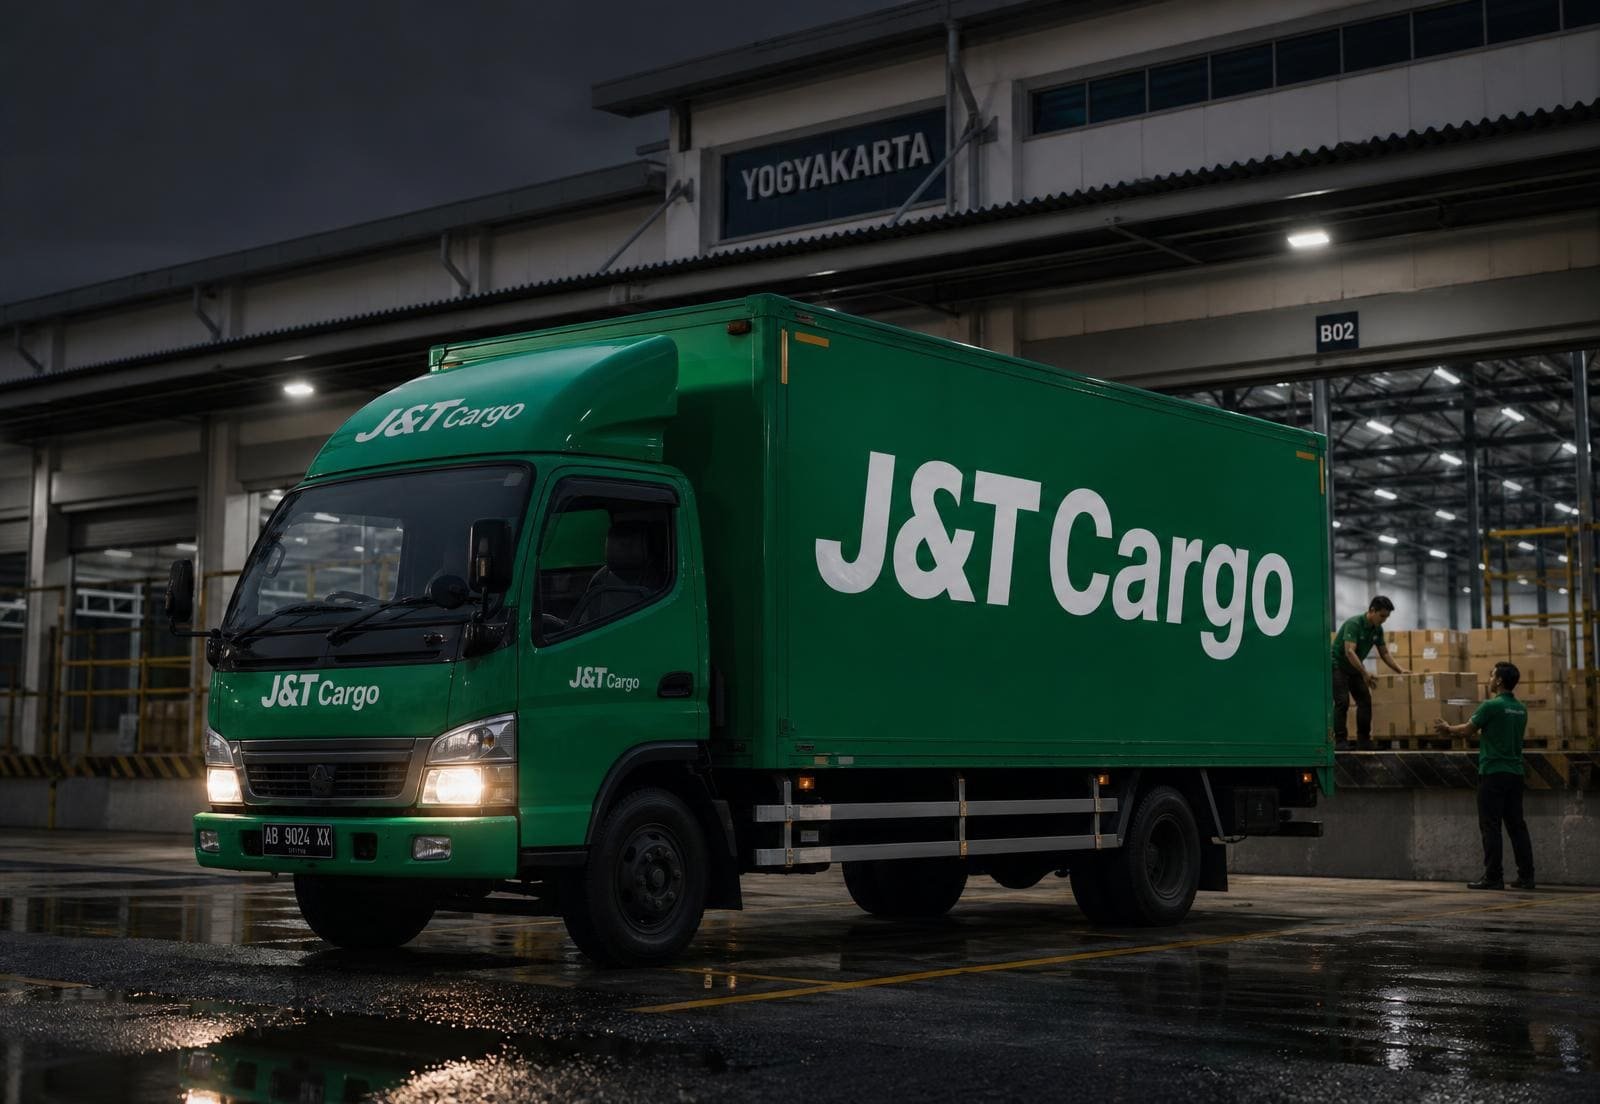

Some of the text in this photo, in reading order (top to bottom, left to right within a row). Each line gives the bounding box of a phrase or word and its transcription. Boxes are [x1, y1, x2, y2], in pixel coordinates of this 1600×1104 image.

[741, 132, 932, 200] YOGYAKARTA
[1320, 321, 1355, 343] B02
[355, 398, 526, 442] J&T Cargo
[815, 450, 1294, 661] J&T Cargo
[260, 673, 380, 711] J&T Cargo
[568, 666, 640, 692] J&T Cargo
[265, 826, 330, 846] AB 9024 XX
